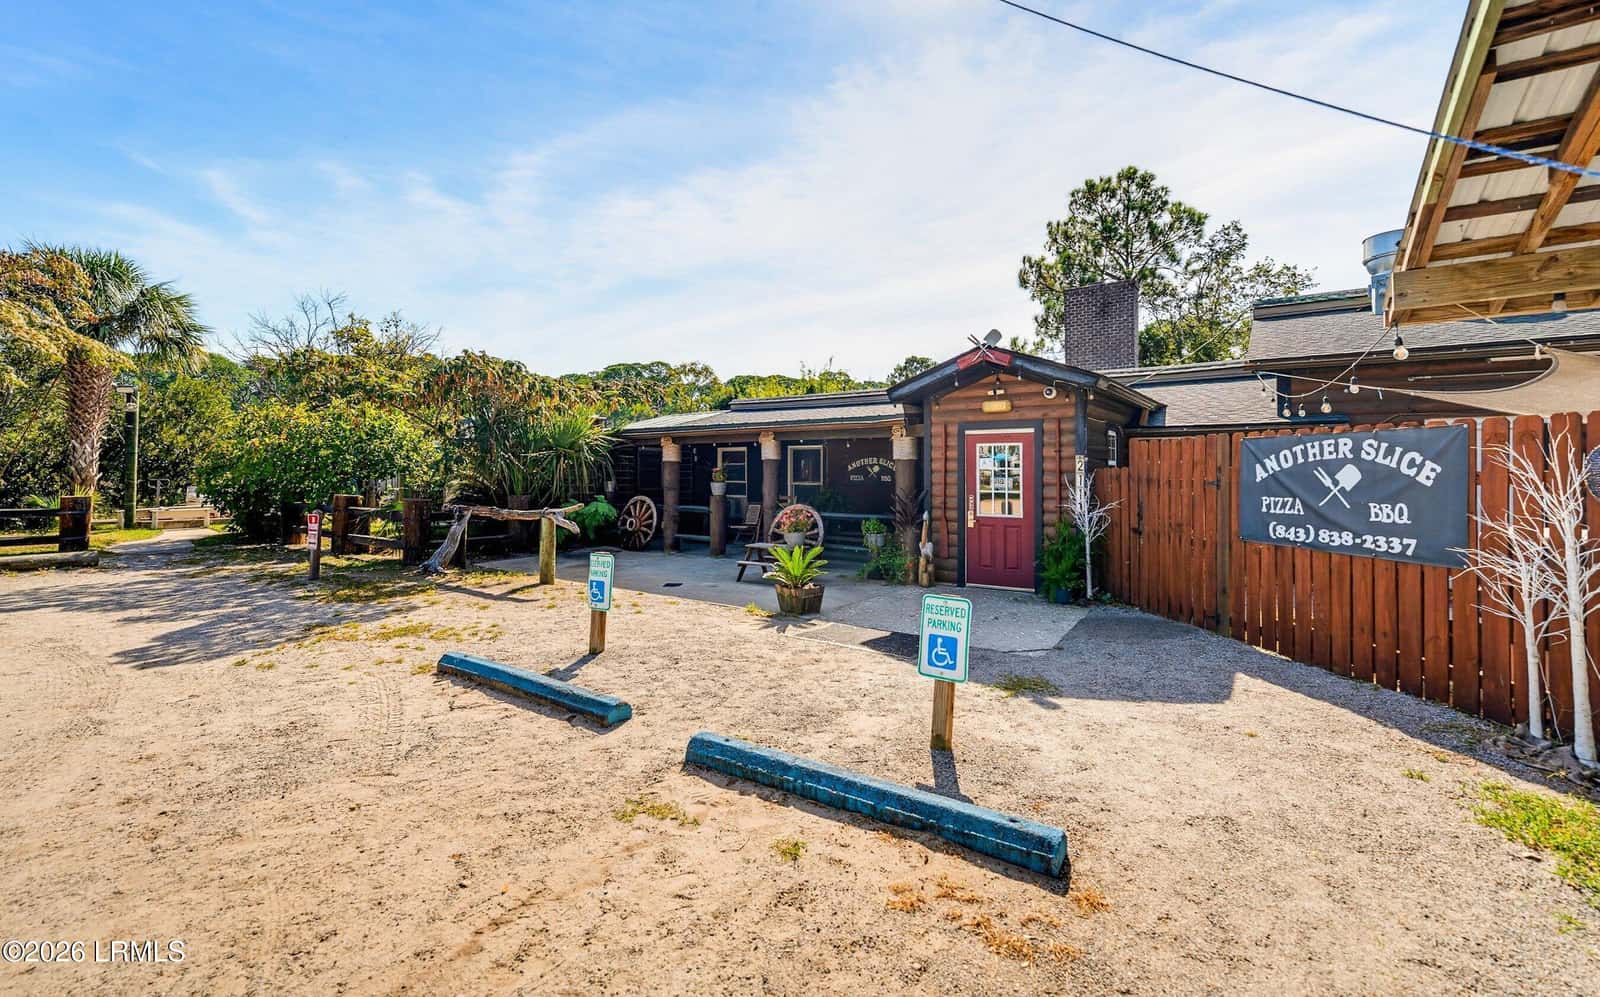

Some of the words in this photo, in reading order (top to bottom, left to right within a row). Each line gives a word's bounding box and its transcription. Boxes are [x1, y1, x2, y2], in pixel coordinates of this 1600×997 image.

[848, 457, 878, 471] ANOTHER
[1255, 437, 1354, 482] ANOTHER
[1360, 439, 1442, 487] SLICE
[1261, 496, 1305, 515] PIZZA
[1368, 502, 1412, 524] BBQ
[1268, 521, 1315, 543] (843)
[1317, 528, 1417, 556] 838-2337
[926, 604, 966, 618] RESERVED
[928, 618, 962, 632] PARKING
